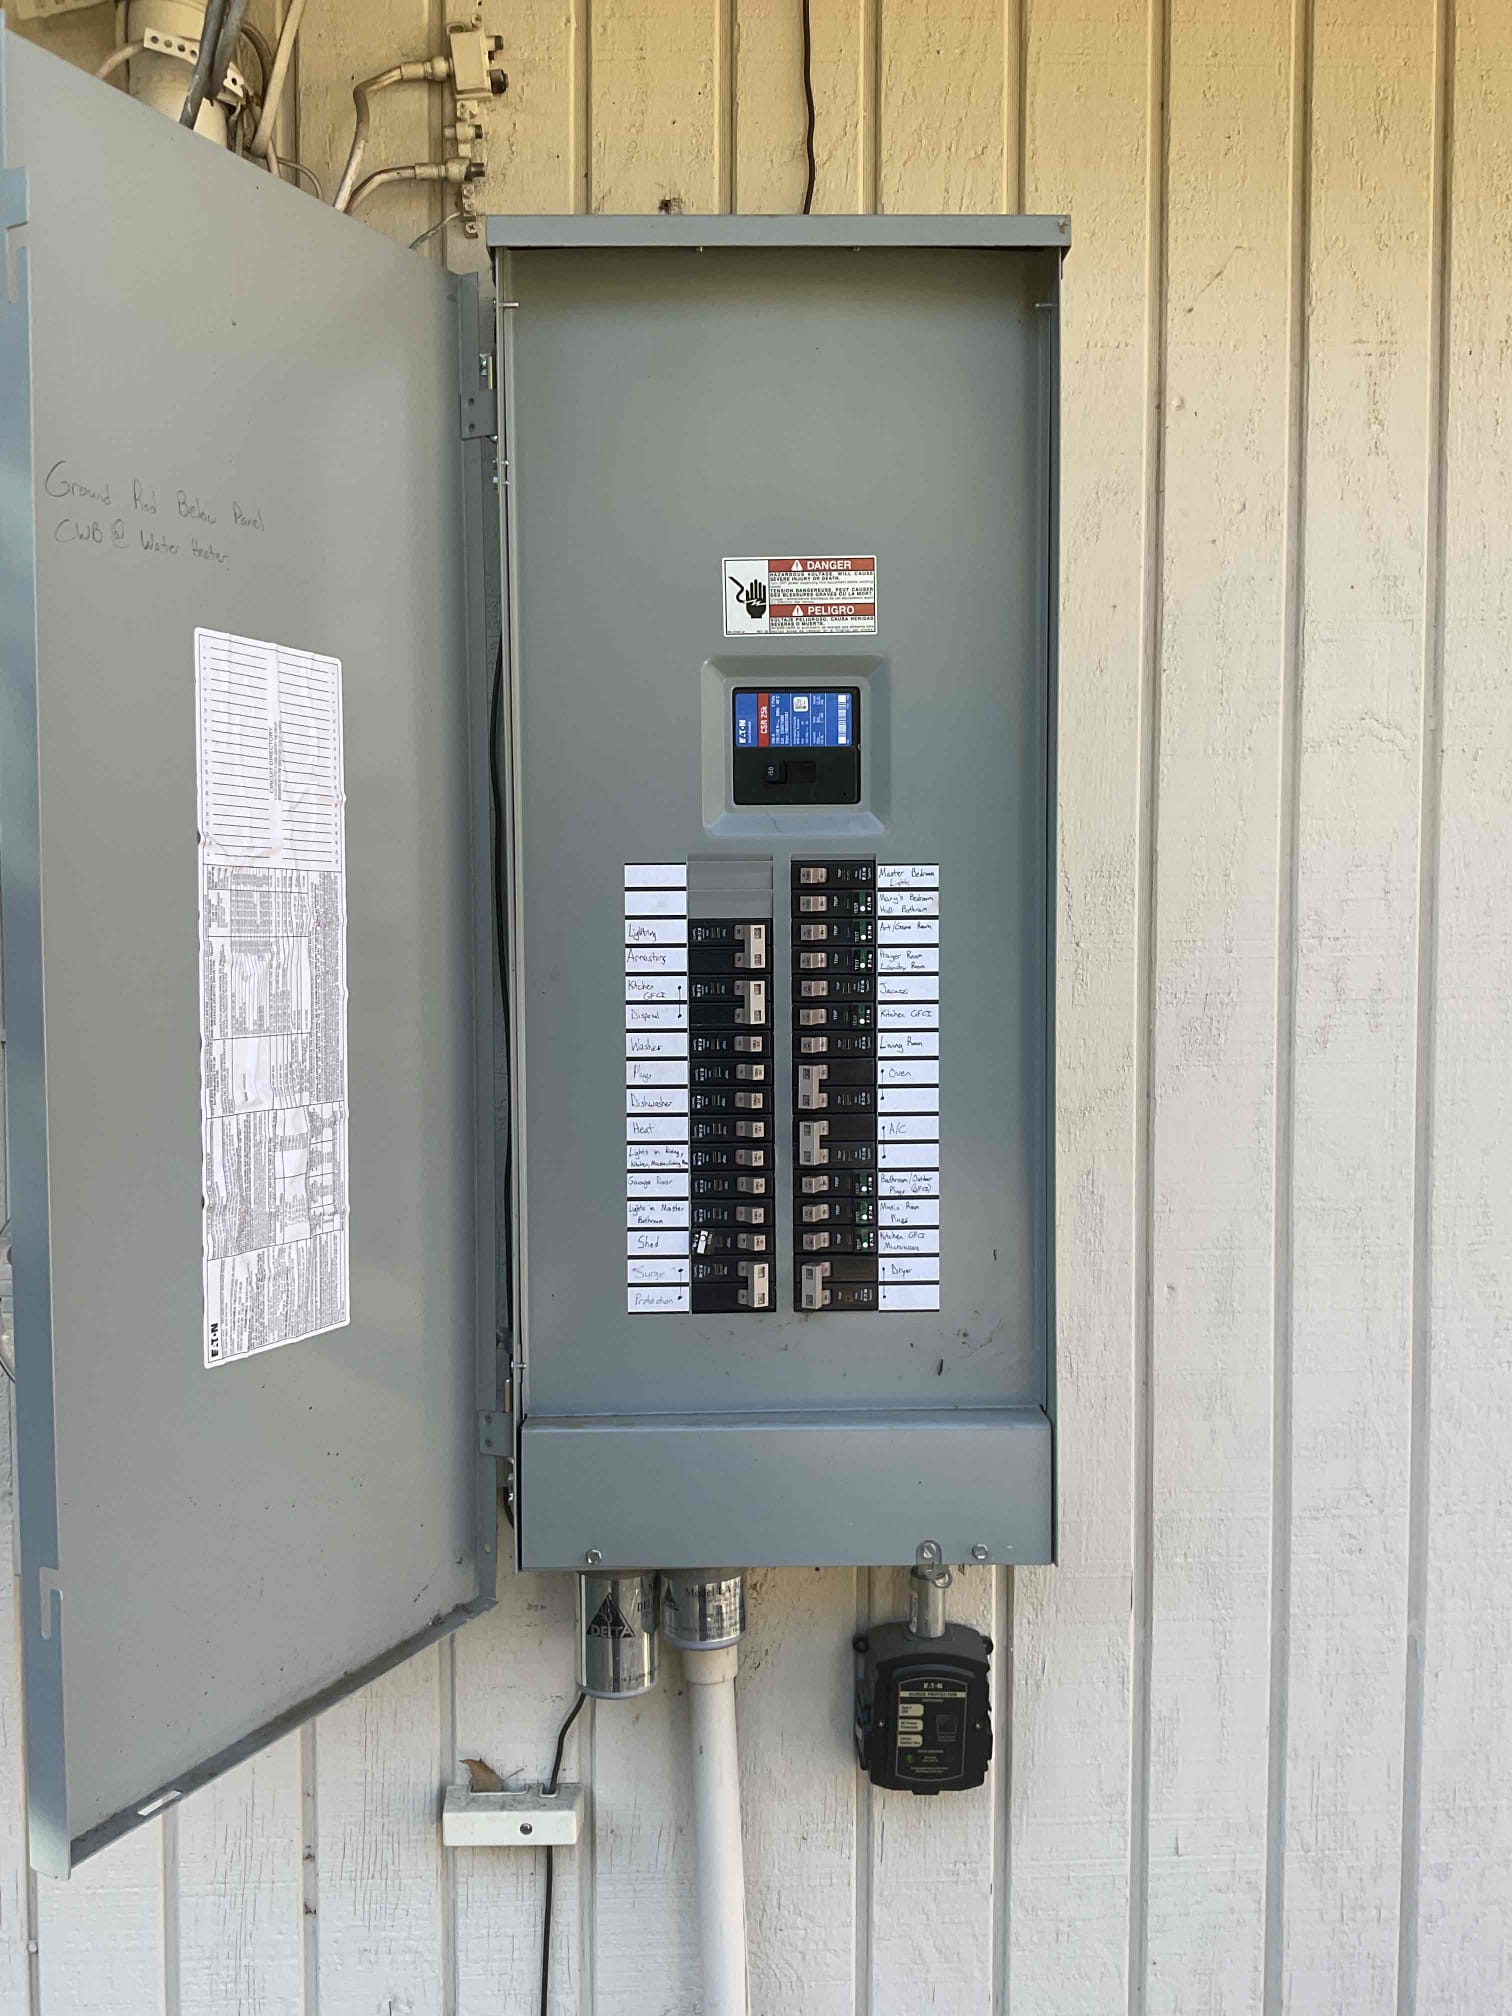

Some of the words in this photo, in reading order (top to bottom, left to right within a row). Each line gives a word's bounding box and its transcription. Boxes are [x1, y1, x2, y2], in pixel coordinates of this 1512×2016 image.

[45, 460, 111, 506] Ground
[133, 479, 157, 514] Rod
[176, 490, 217, 526] Below
[233, 500, 264, 531] Panel
[140, 529, 180, 555] Water
[191, 537, 229, 564] Heater
[807, 561, 852, 571] DANGER
[808, 605, 855, 616] PELIGRO
[760, 719, 768, 734] CSR
[878, 867, 904, 879] Master
[643, 991, 667, 1001] GFCI
[630, 1037, 663, 1052] Washer
[888, 1068, 912, 1078] Oven
[630, 1092, 674, 1109] Dishwasher
[631, 1121, 655, 1136] Heat
[889, 1121, 906, 1135] A/C
[637, 1235, 660, 1249] Shed
[891, 1263, 913, 1278] Dryer
[634, 1293, 674, 1306] Protection
[590, 1624, 635, 1638] DELTA
